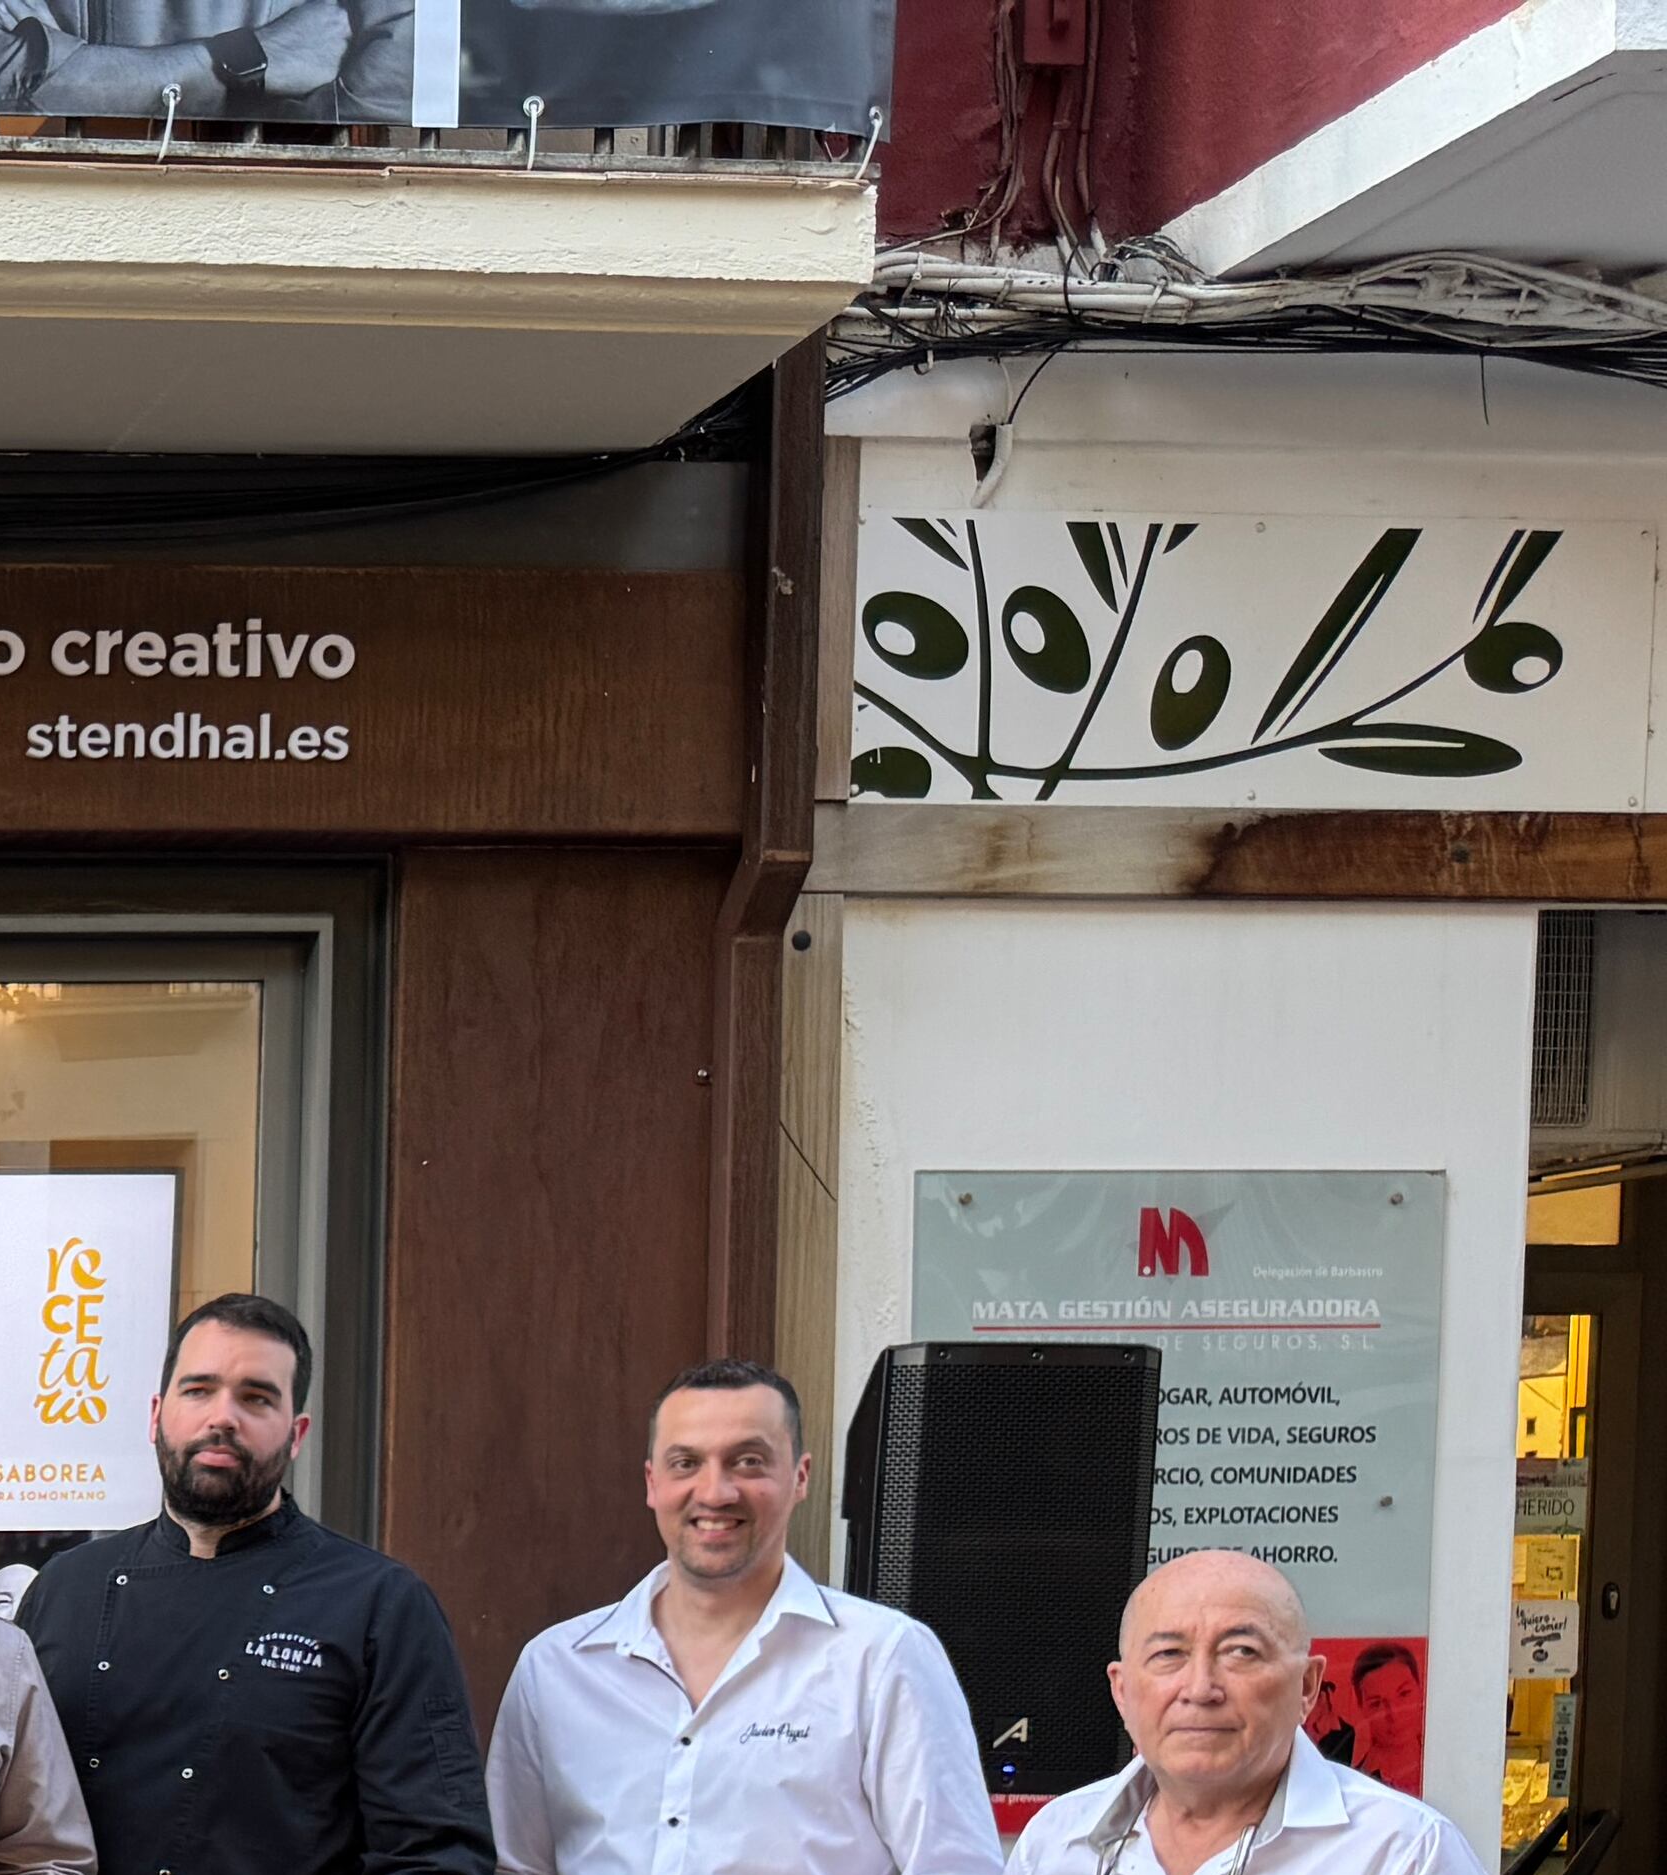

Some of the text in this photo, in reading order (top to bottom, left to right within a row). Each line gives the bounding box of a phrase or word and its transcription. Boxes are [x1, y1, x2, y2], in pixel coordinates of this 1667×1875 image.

[51, 618, 356, 680] creativo
[25, 712, 351, 761] stendhal.es
[972, 1296, 1381, 1321] MATA GESTIÓN ASEGURADORA
[1219, 1381, 1340, 1406] AUTOMÓVIL,
[1196, 1427, 1222, 1445] DE
[1228, 1427, 1280, 1446] VIDA,
[1286, 1426, 1377, 1444] SEGUROS
[1210, 1466, 1357, 1485] COMUNIDADES
[20, 1490, 106, 1501] SOMONTANO
[1184, 1505, 1339, 1525] EXPLOTACIONES
[1250, 1545, 1338, 1563] AHORRO.
[245, 1641, 265, 1657] LA
[271, 1645, 322, 1668] LONJA
